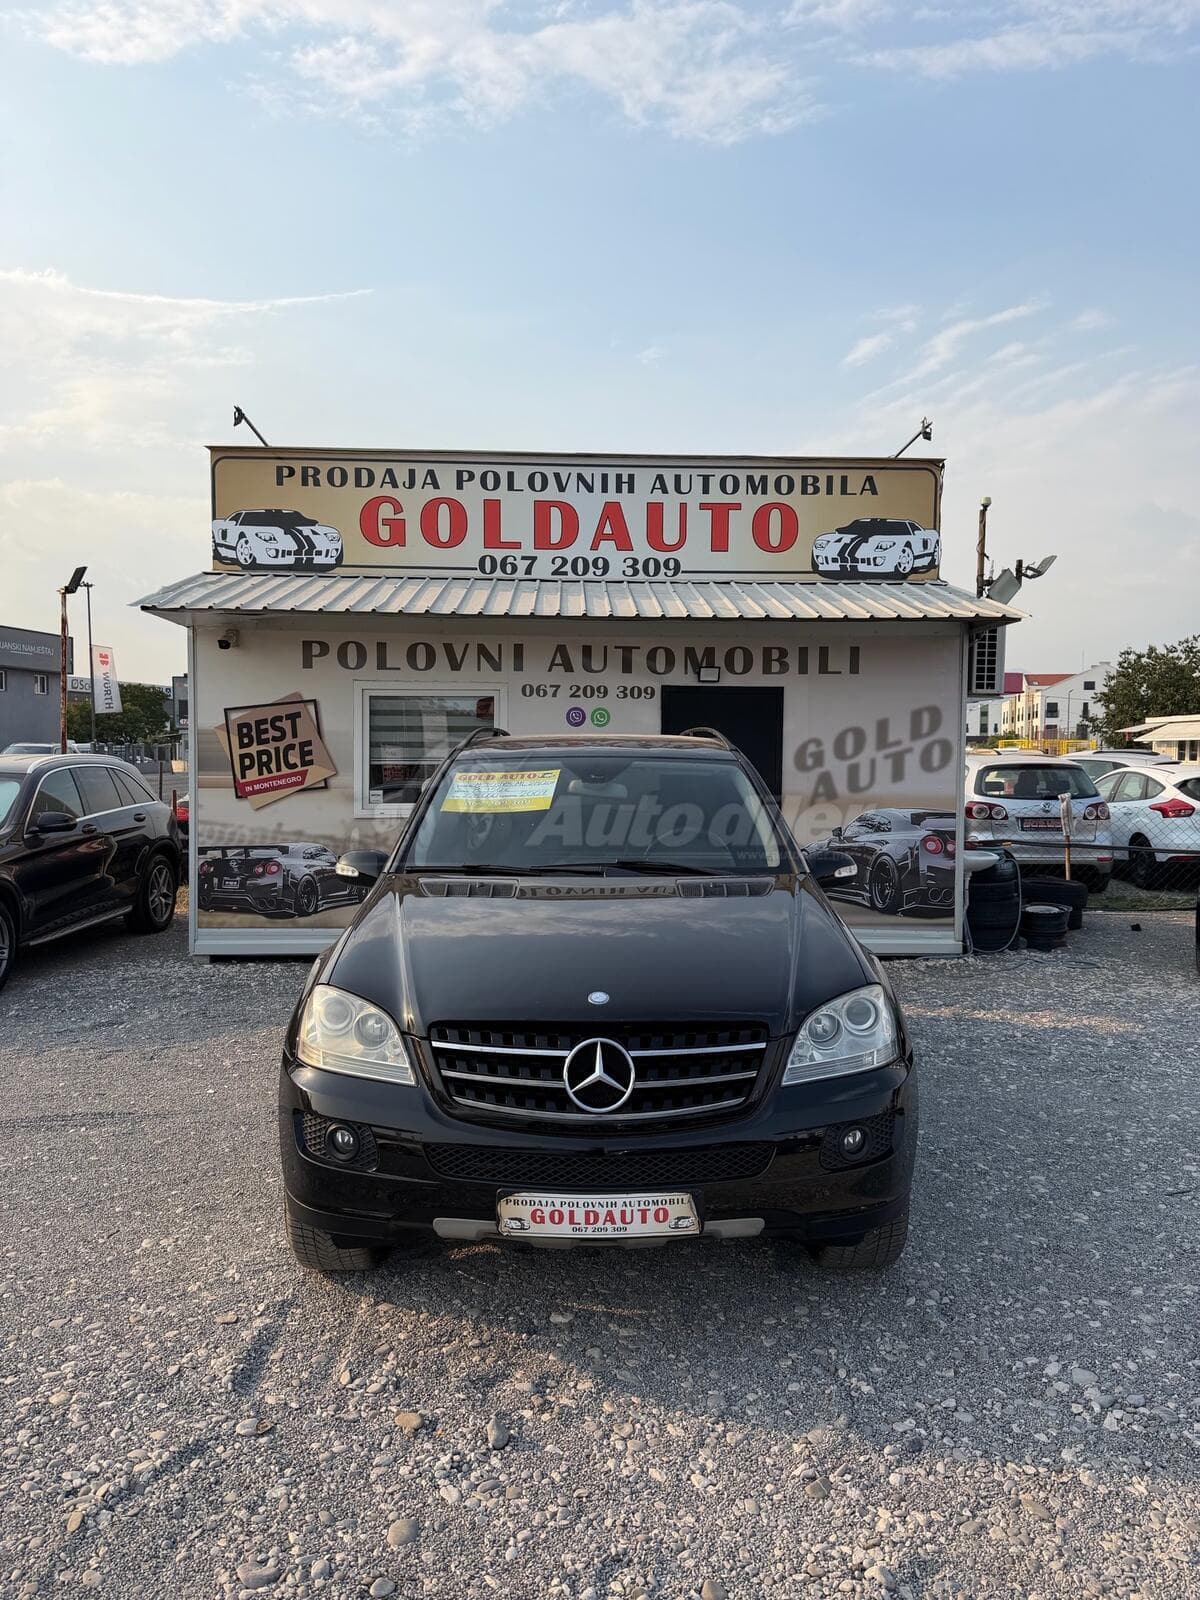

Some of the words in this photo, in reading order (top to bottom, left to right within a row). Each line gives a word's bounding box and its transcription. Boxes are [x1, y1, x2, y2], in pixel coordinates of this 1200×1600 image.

[275, 464, 441, 490] PRODAJA
[455, 468, 636, 494] POLOVNIH
[650, 472, 879, 496] AUTOMOBILA
[359, 495, 799, 553] GOLDAUTO
[478, 554, 539, 577] 067
[551, 555, 610, 577] 209
[622, 556, 682, 578] 309
[302, 640, 525, 672] POLOVNI
[547, 643, 861, 675] AUTOMOBILI
[102, 672, 114, 709] WÜRTH
[521, 684, 561, 698] 067
[569, 684, 609, 699] 209
[616, 685, 656, 700] 309
[237, 711, 302, 749] BEST
[793, 705, 942, 772] GOLD
[238, 739, 314, 780] PRICE
[500, 772, 537, 780] AUTO
[809, 737, 954, 806] AUTO
[253, 775, 302, 790] MONTENEGRO
[505, 1199, 556, 1208] PRODAJA
[560, 1200, 618, 1209] POLOVNIH
[530, 1207, 670, 1226] GOLDAUTO
